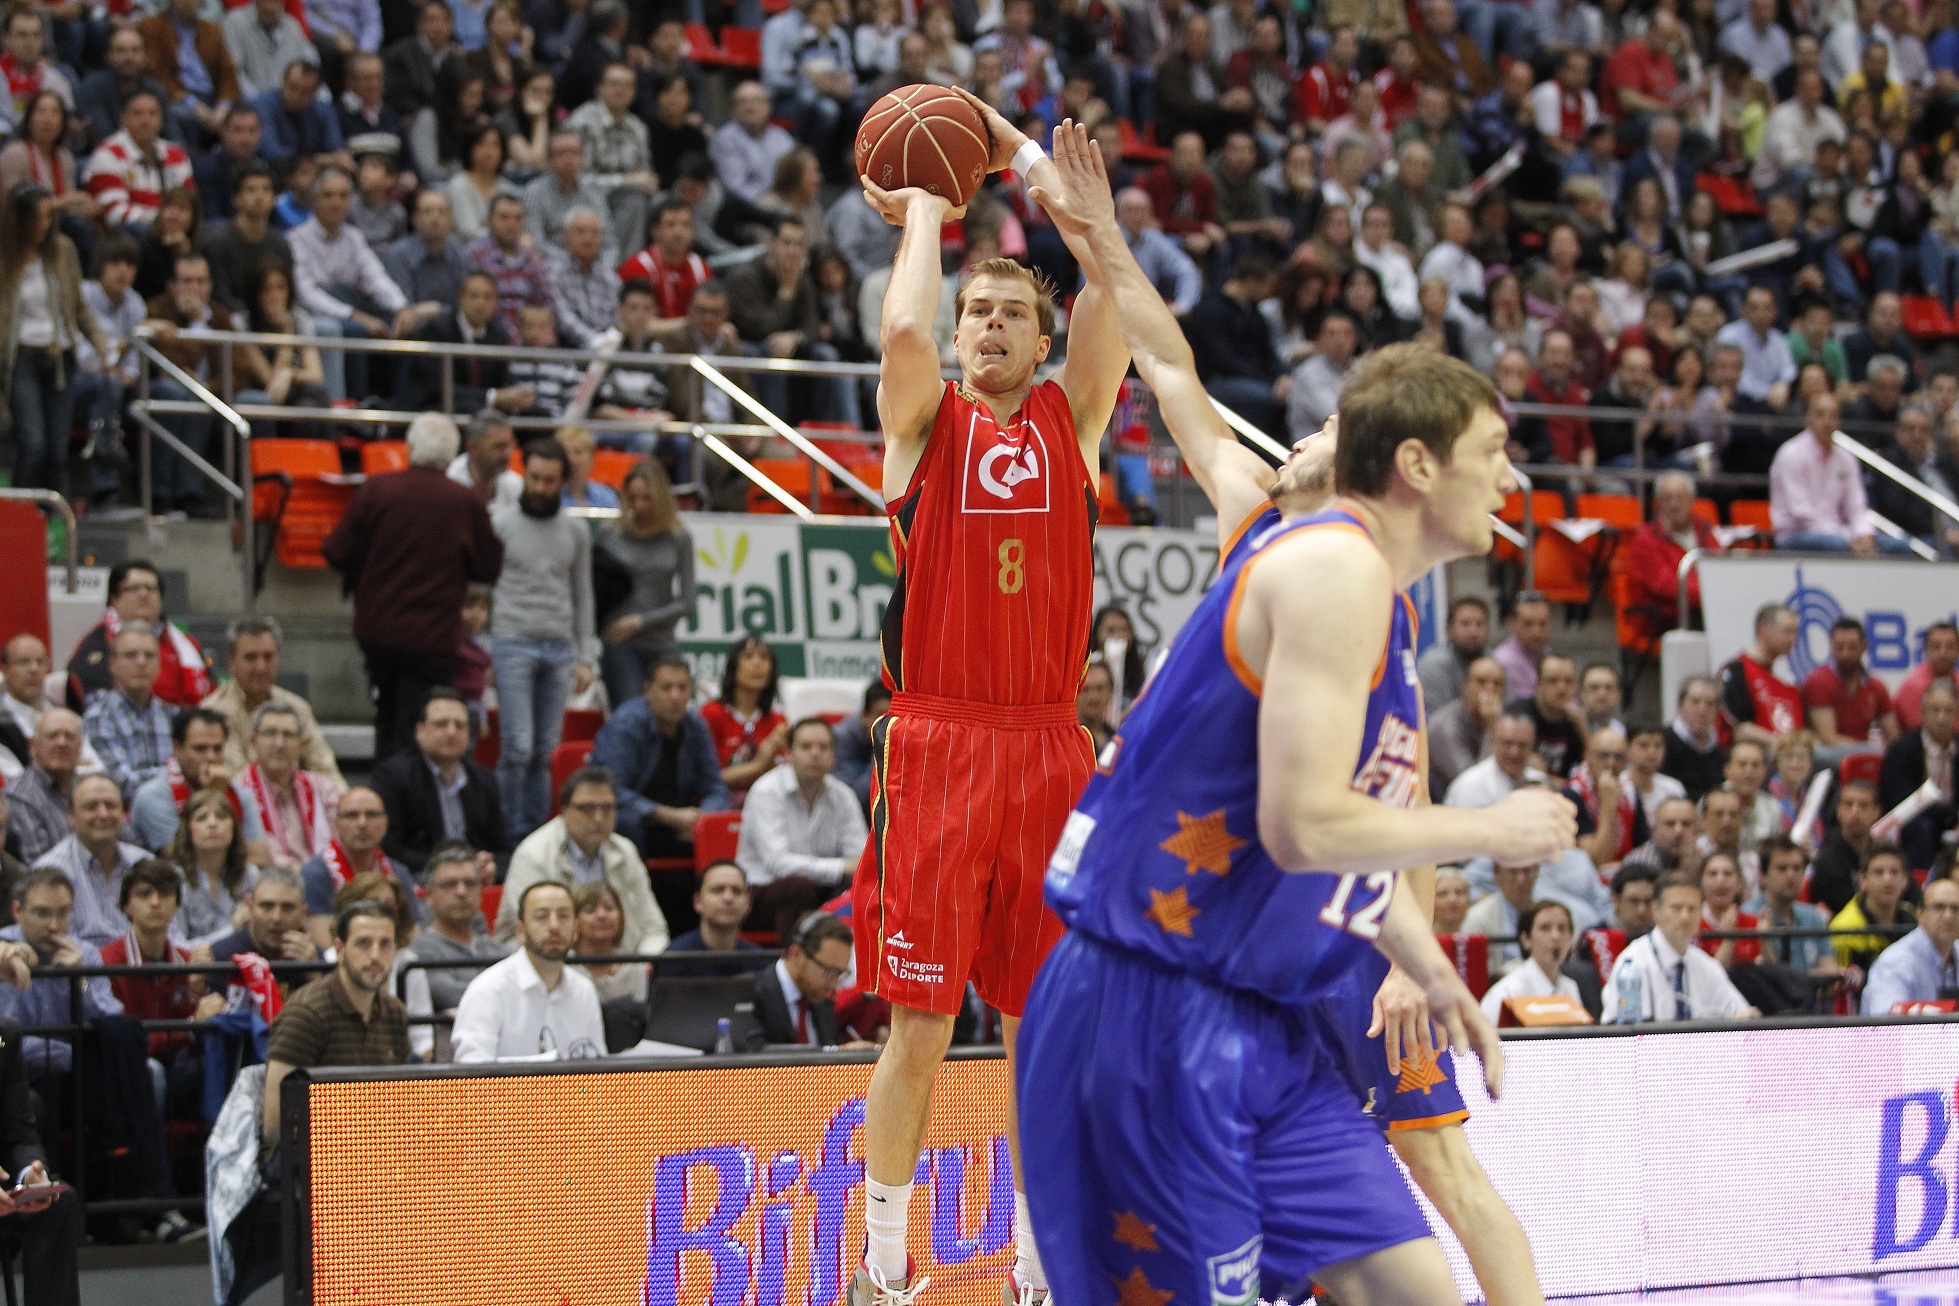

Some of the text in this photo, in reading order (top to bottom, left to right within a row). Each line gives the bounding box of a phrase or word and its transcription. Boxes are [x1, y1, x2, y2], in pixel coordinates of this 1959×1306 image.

[998, 538, 1024, 594] 8
[1319, 872, 1394, 940] 12
[900, 969, 944, 983] DEPORTE
[901, 957, 944, 973] Zaragoza
